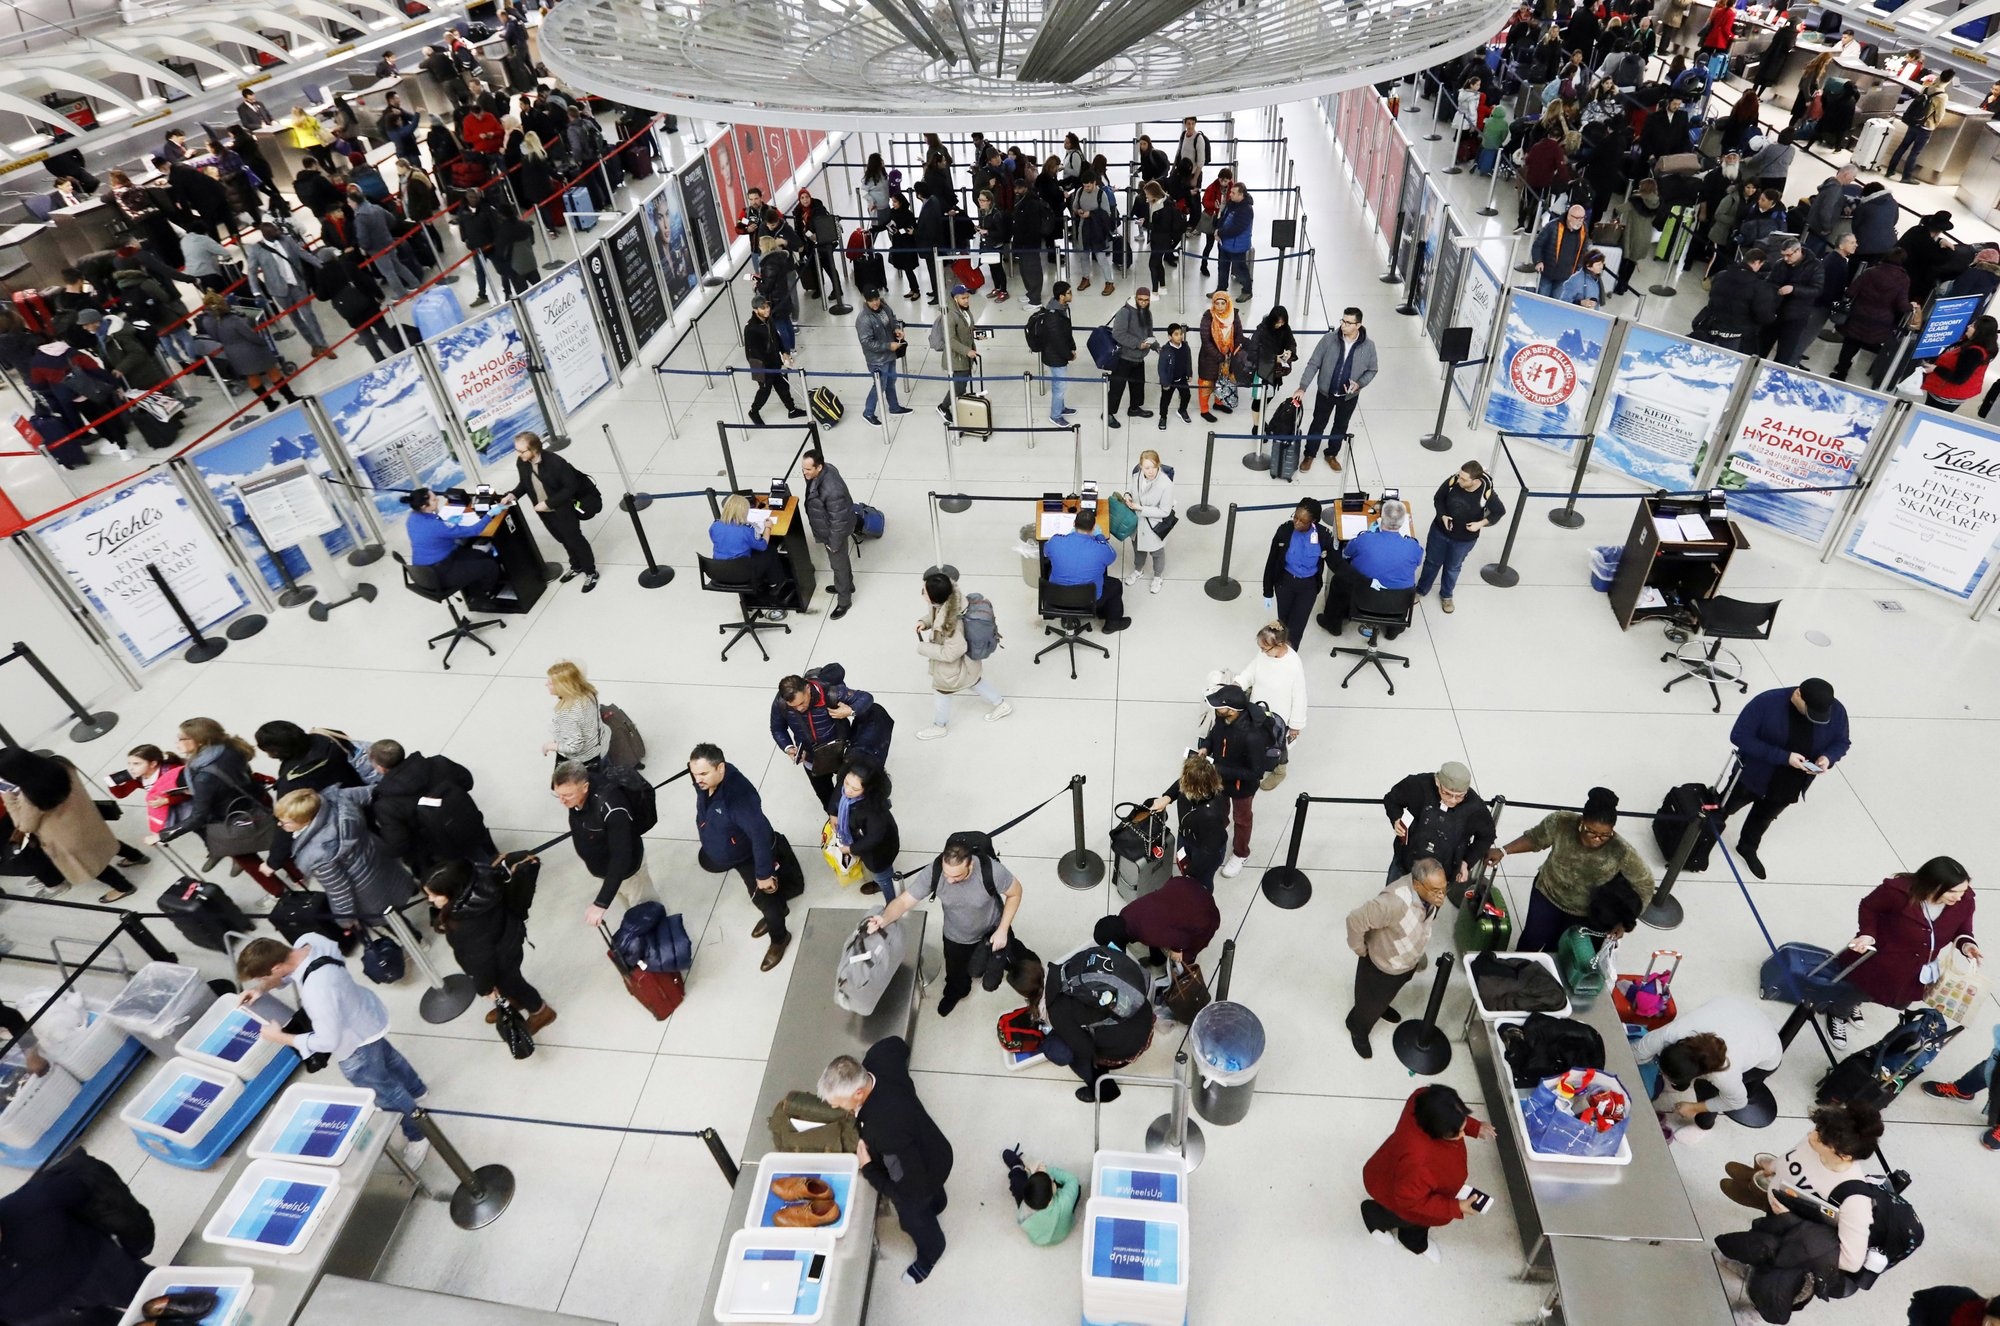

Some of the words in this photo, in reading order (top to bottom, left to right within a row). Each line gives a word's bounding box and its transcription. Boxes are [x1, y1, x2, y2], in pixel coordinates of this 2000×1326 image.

[543, 292, 576, 324] Kiehl's
[1930, 319, 1963, 328] ECONOMY
[461, 352, 514, 385] 24-HOUR
[1518, 350, 1532, 362] OUR
[1532, 346, 1552, 354] BEST
[1552, 350, 1574, 378] SELLING
[1527, 362, 1558, 390] #1
[456, 359, 528, 402] HYDRATION
[1515, 379, 1564, 403] MOISTURIZER
[471, 412, 492, 426] ULTRA
[1761, 418, 1844, 451] 24-HOUR
[1743, 426, 1852, 470] HYDRATION
[1735, 460, 1762, 474] ULTRA
[1764, 471, 1796, 486] FACIAL
[1892, 483, 2000, 524] APOTHECARY
[1922, 479, 1984, 505] FINEST
[1898, 497, 1984, 532] SKINCARE
[86, 508, 163, 556] Kiehl's
[116, 540, 170, 574] FINEST
[304, 1119, 349, 1131] #WheelsUp
[1114, 1185, 1163, 1198] #WheelsUp
[1785, 1149, 1830, 1204] LOV
[264, 1198, 310, 1214] #WheelsUp
[1110, 1252, 1162, 1268] #WheelsUp
